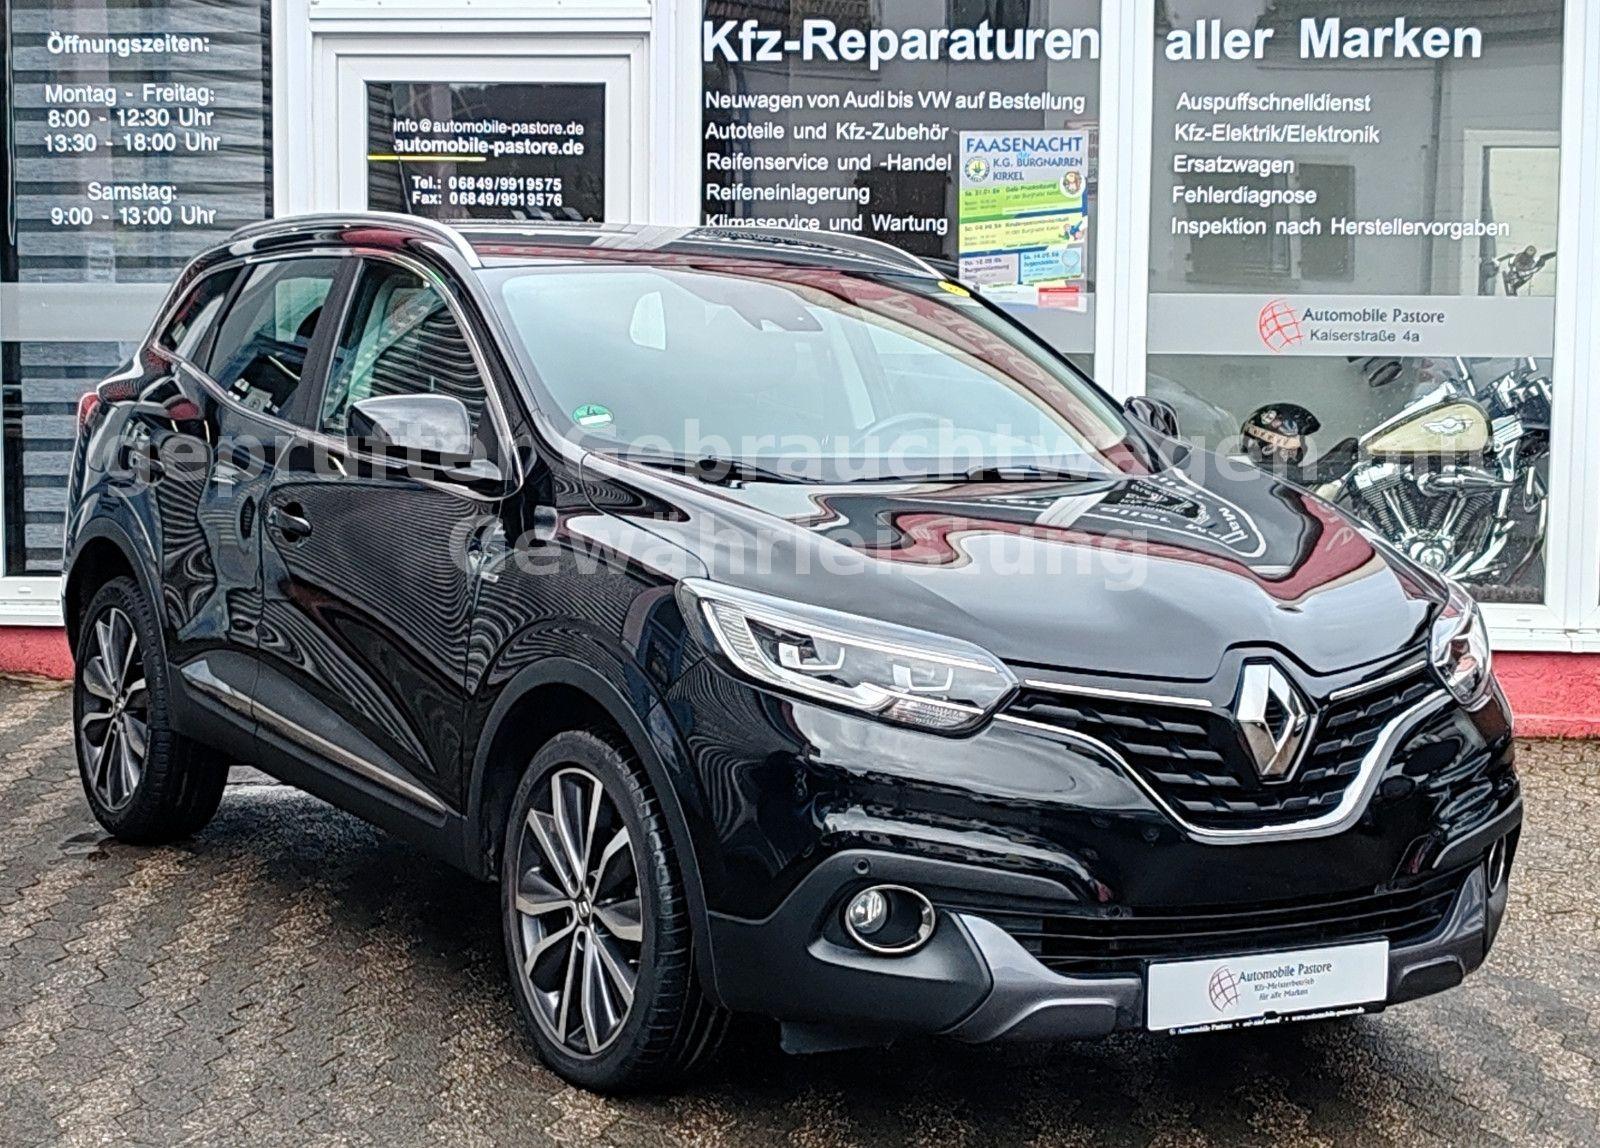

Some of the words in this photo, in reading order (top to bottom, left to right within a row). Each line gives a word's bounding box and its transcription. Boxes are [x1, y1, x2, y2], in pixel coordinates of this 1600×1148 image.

[47, 32, 210, 57] Öffnungszeiten:
[703, 19, 1100, 71] Kfz-Reparaturen
[1165, 19, 1275, 61] aller
[1299, 17, 1483, 60] Marken
[45, 85, 117, 106] Montag
[142, 83, 216, 105] Freitag:
[705, 91, 803, 109] Neuwagen
[807, 92, 839, 109] von
[843, 91, 885, 108] Audi
[887, 91, 913, 108] bis
[918, 91, 951, 109] VW
[955, 91, 985, 109] auf
[989, 92, 1085, 113] Bestellung
[1176, 92, 1372, 114] Auspuffschnelldienst
[48, 110, 90, 128] 8:00
[117, 108, 170, 127] 12:30
[178, 109, 215, 127] Uhr
[705, 122, 785, 140] Autoteile
[793, 123, 827, 140] und
[835, 123, 949, 141] Kfz-Zubehör
[1174, 124, 1381, 144] Kfz-Elektrik/Elektronik
[44, 134, 97, 152] 13:30
[123, 133, 177, 151] 18:00
[185, 133, 221, 151] Uhr
[966, 136, 1084, 153] FAASENACHT
[706, 153, 829, 171] Reifenservice
[837, 153, 871, 170] und
[879, 153, 952, 171] -Handel
[993, 158, 1014, 167] K.G.
[1016, 158, 1083, 168] BURGNARREN
[1173, 155, 1295, 175] Ersatzwagen
[412, 175, 442, 190] Tel.:
[448, 177, 563, 192] 06849/9919575
[993, 171, 1024, 181] KIRKEL
[87, 182, 178, 204] Samstag:
[412, 192, 442, 206] Fax:
[449, 193, 563, 208] 06849/9919576
[706, 183, 870, 204] Reifeneinlagerung
[1172, 186, 1317, 207] Fehlerdiagnose
[51, 208, 93, 226] 9:00
[119, 207, 172, 225] 13:00
[180, 206, 217, 225] Uhr
[705, 214, 821, 231] Klimaservice
[829, 214, 863, 231] und
[872, 213, 949, 235] Wartung
[1171, 218, 1267, 238] Inspektion
[1276, 217, 1322, 236] nach
[1331, 217, 1510, 238] Herstellervorgaben
[1302, 308, 1387, 324] Automobile
[1392, 308, 1445, 324] Pastore
[1310, 329, 1396, 343] Kaiserstraße
[1402, 331, 1420, 343] 4a
[1239, 966, 1295, 982] Automobile
[1297, 963, 1333, 976] Pastore
